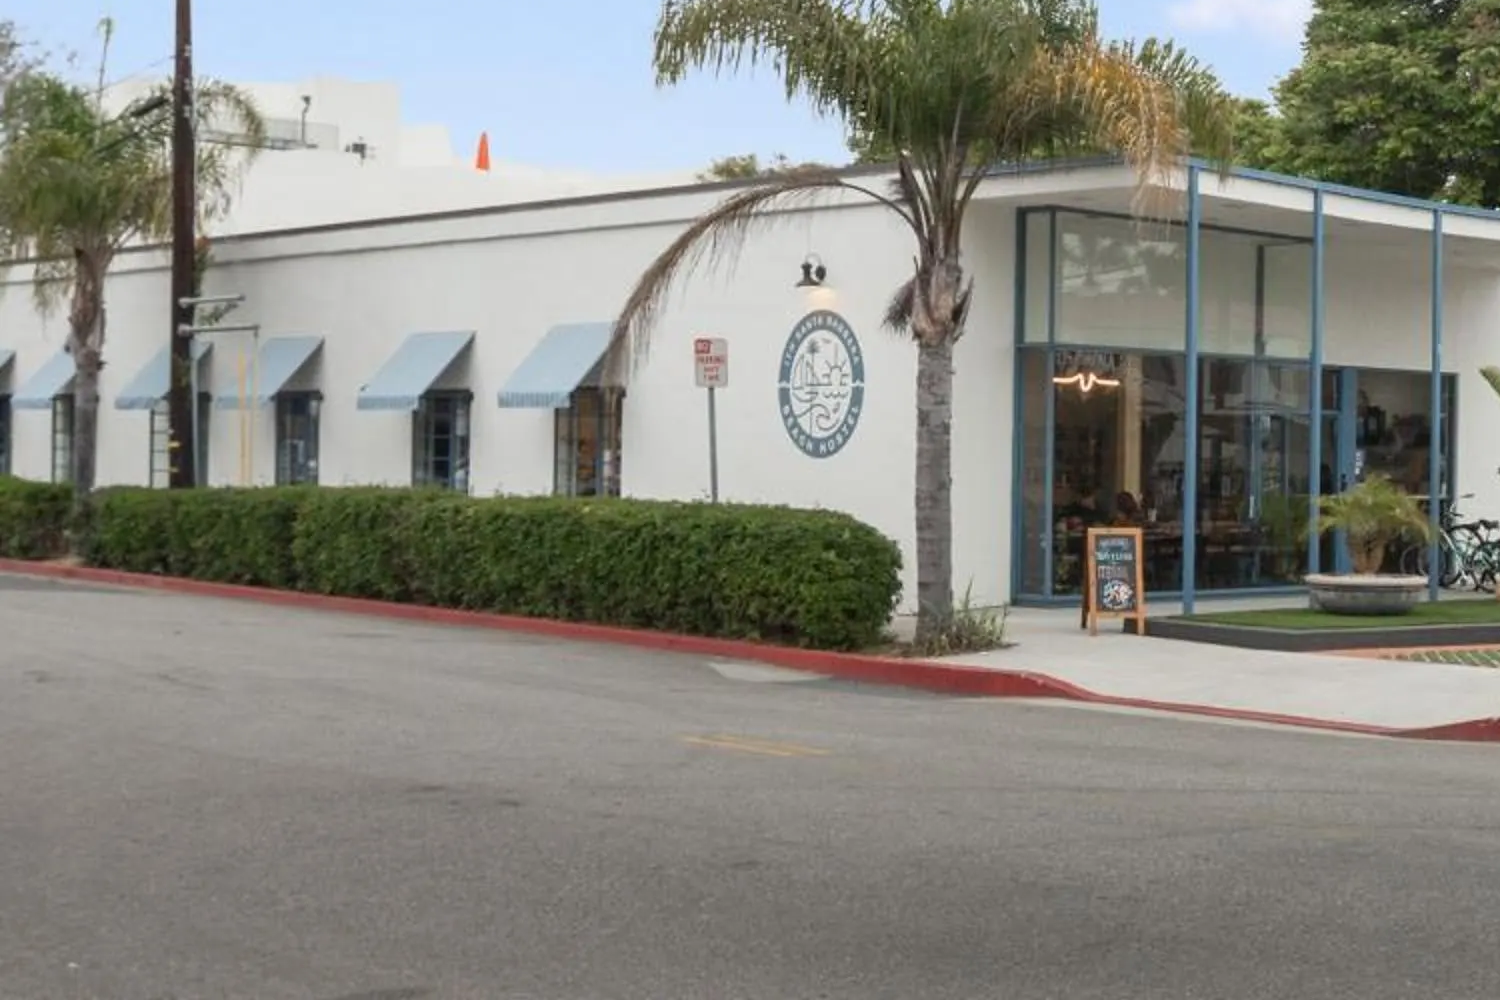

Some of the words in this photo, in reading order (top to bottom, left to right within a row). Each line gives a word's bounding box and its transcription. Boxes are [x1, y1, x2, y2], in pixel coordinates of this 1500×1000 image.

[795, 314, 824, 341] SANTA
[782, 405, 813, 452] BEACH
[819, 406, 859, 454] HOSTEL
